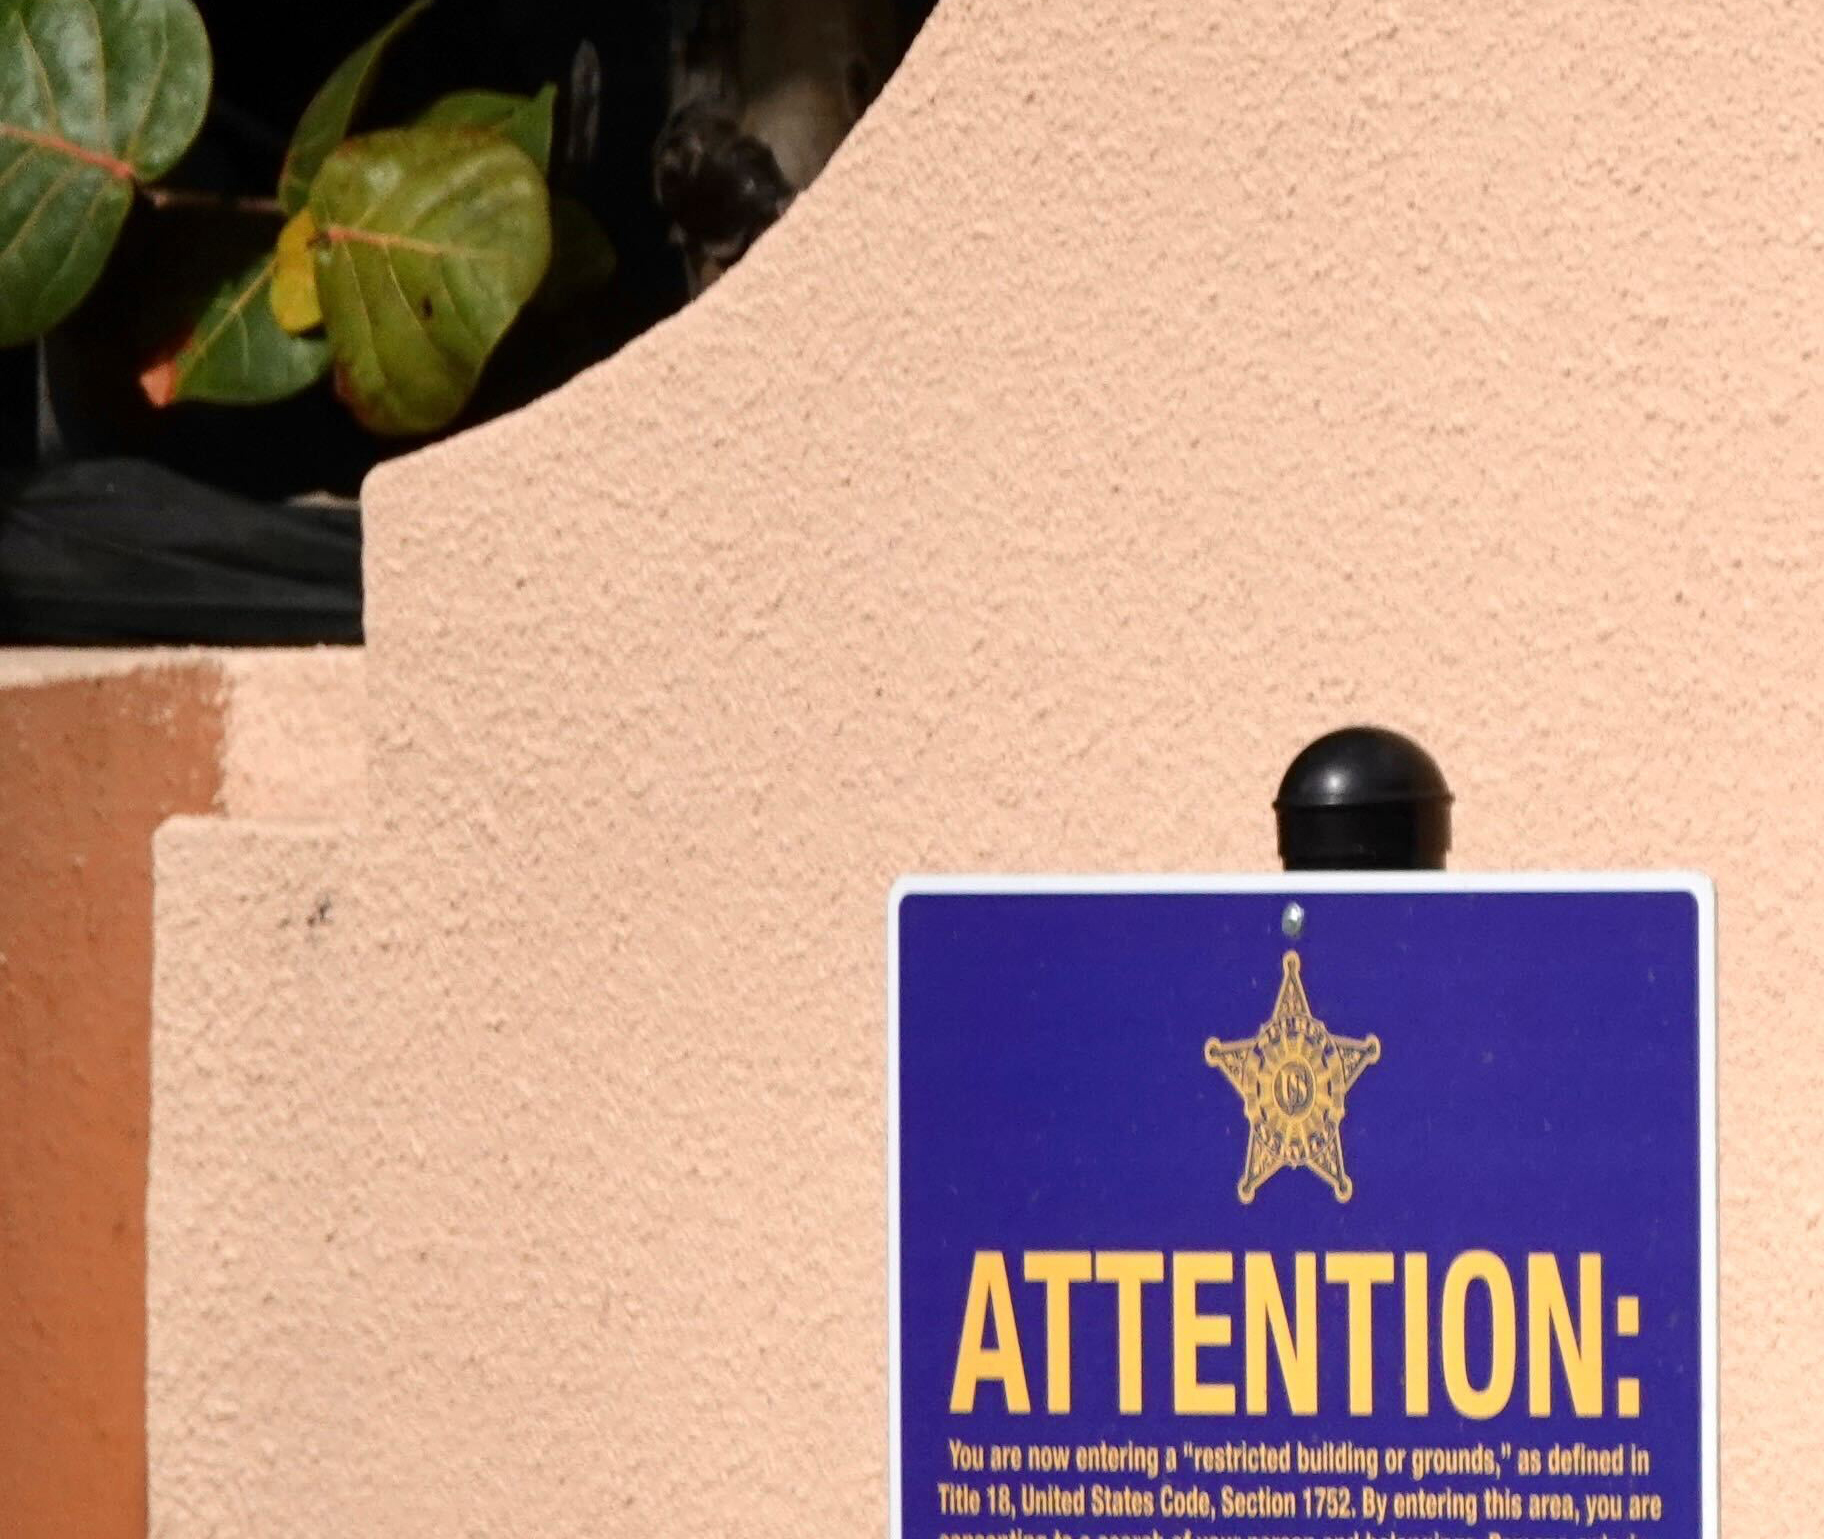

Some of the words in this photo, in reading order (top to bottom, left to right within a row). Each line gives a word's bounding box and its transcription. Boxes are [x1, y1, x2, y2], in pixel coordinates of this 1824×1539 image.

[949, 1248, 1640, 1421] ATTENTION:
[948, 1438, 985, 1472] You
[990, 1445, 1022, 1472] are
[1027, 1445, 1070, 1472] now
[1075, 1440, 1159, 1479] entering
[1165, 1446, 1177, 1473] a
[1296, 1440, 1379, 1481] building
[1384, 1447, 1407, 1475] or
[1517, 1448, 1542, 1476] as
[1547, 1442, 1624, 1476] defined
[1630, 1443, 1650, 1476] in
[937, 1482, 981, 1516] Title
[986, 1483, 1016, 1521] 18,
[1021, 1484, 1086, 1517] United
[1090, 1483, 1155, 1517] States
[1159, 1484, 1216, 1522] Code,
[1220, 1484, 1296, 1518] Section
[1302, 1486, 1357, 1519] 1752.
[1362, 1485, 1388, 1525] By
[1393, 1486, 1478, 1527] entering
[1483, 1486, 1523, 1520] this
[1528, 1493, 1580, 1526] area,
[1585, 1494, 1623, 1527] you
[1628, 1494, 1662, 1521] are
